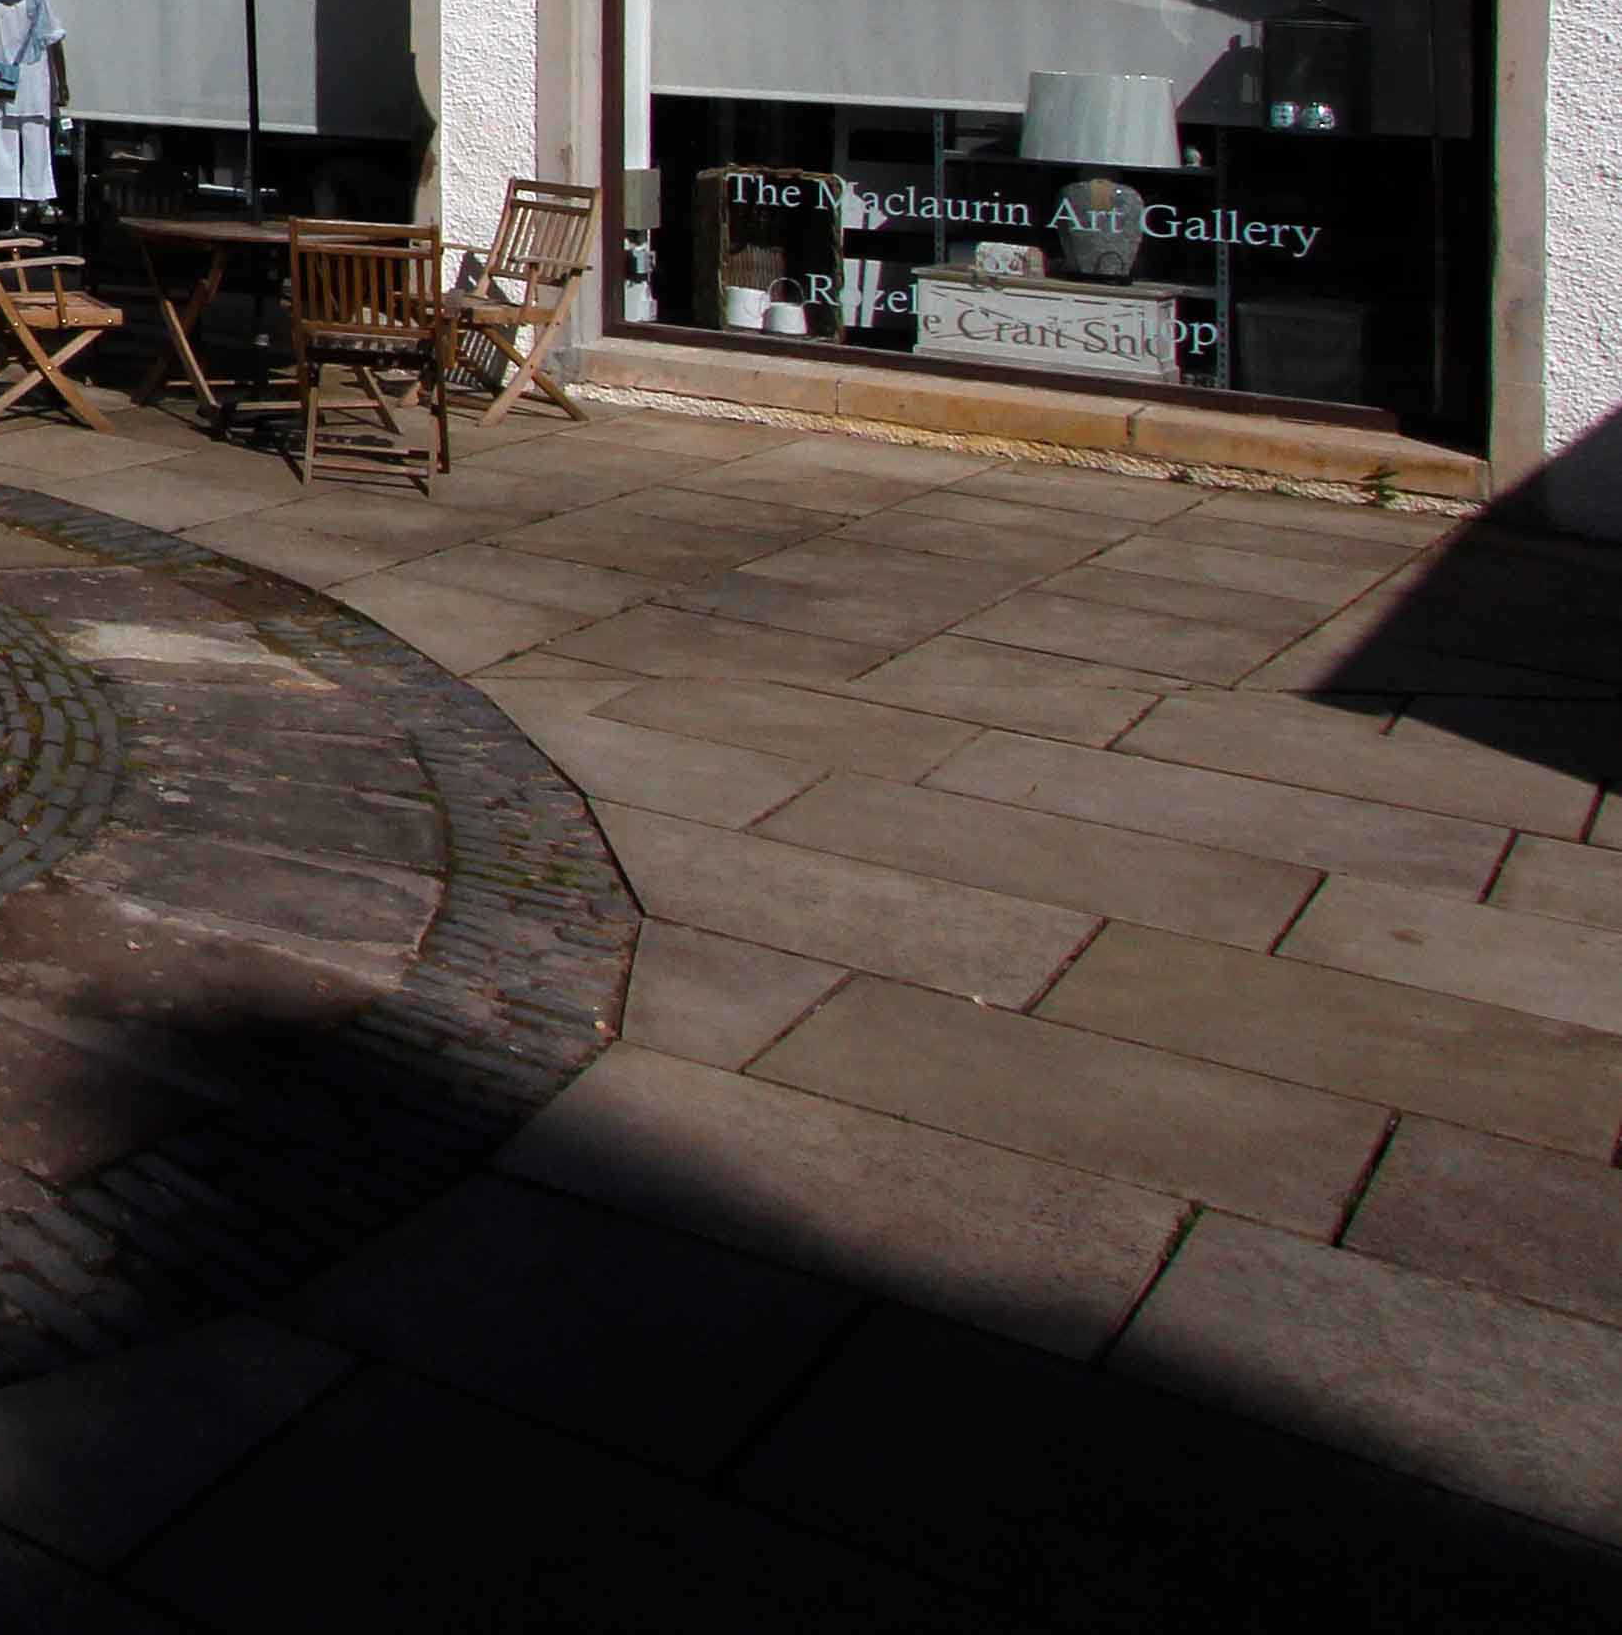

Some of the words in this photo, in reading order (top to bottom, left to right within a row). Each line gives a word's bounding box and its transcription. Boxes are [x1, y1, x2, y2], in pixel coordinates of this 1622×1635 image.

[724, 172, 802, 208] The
[815, 174, 1032, 227] Maclaurin
[1046, 197, 1124, 234] Art
[1139, 204, 1322, 258] Gallery
[804, 272, 941, 334] Rzele
